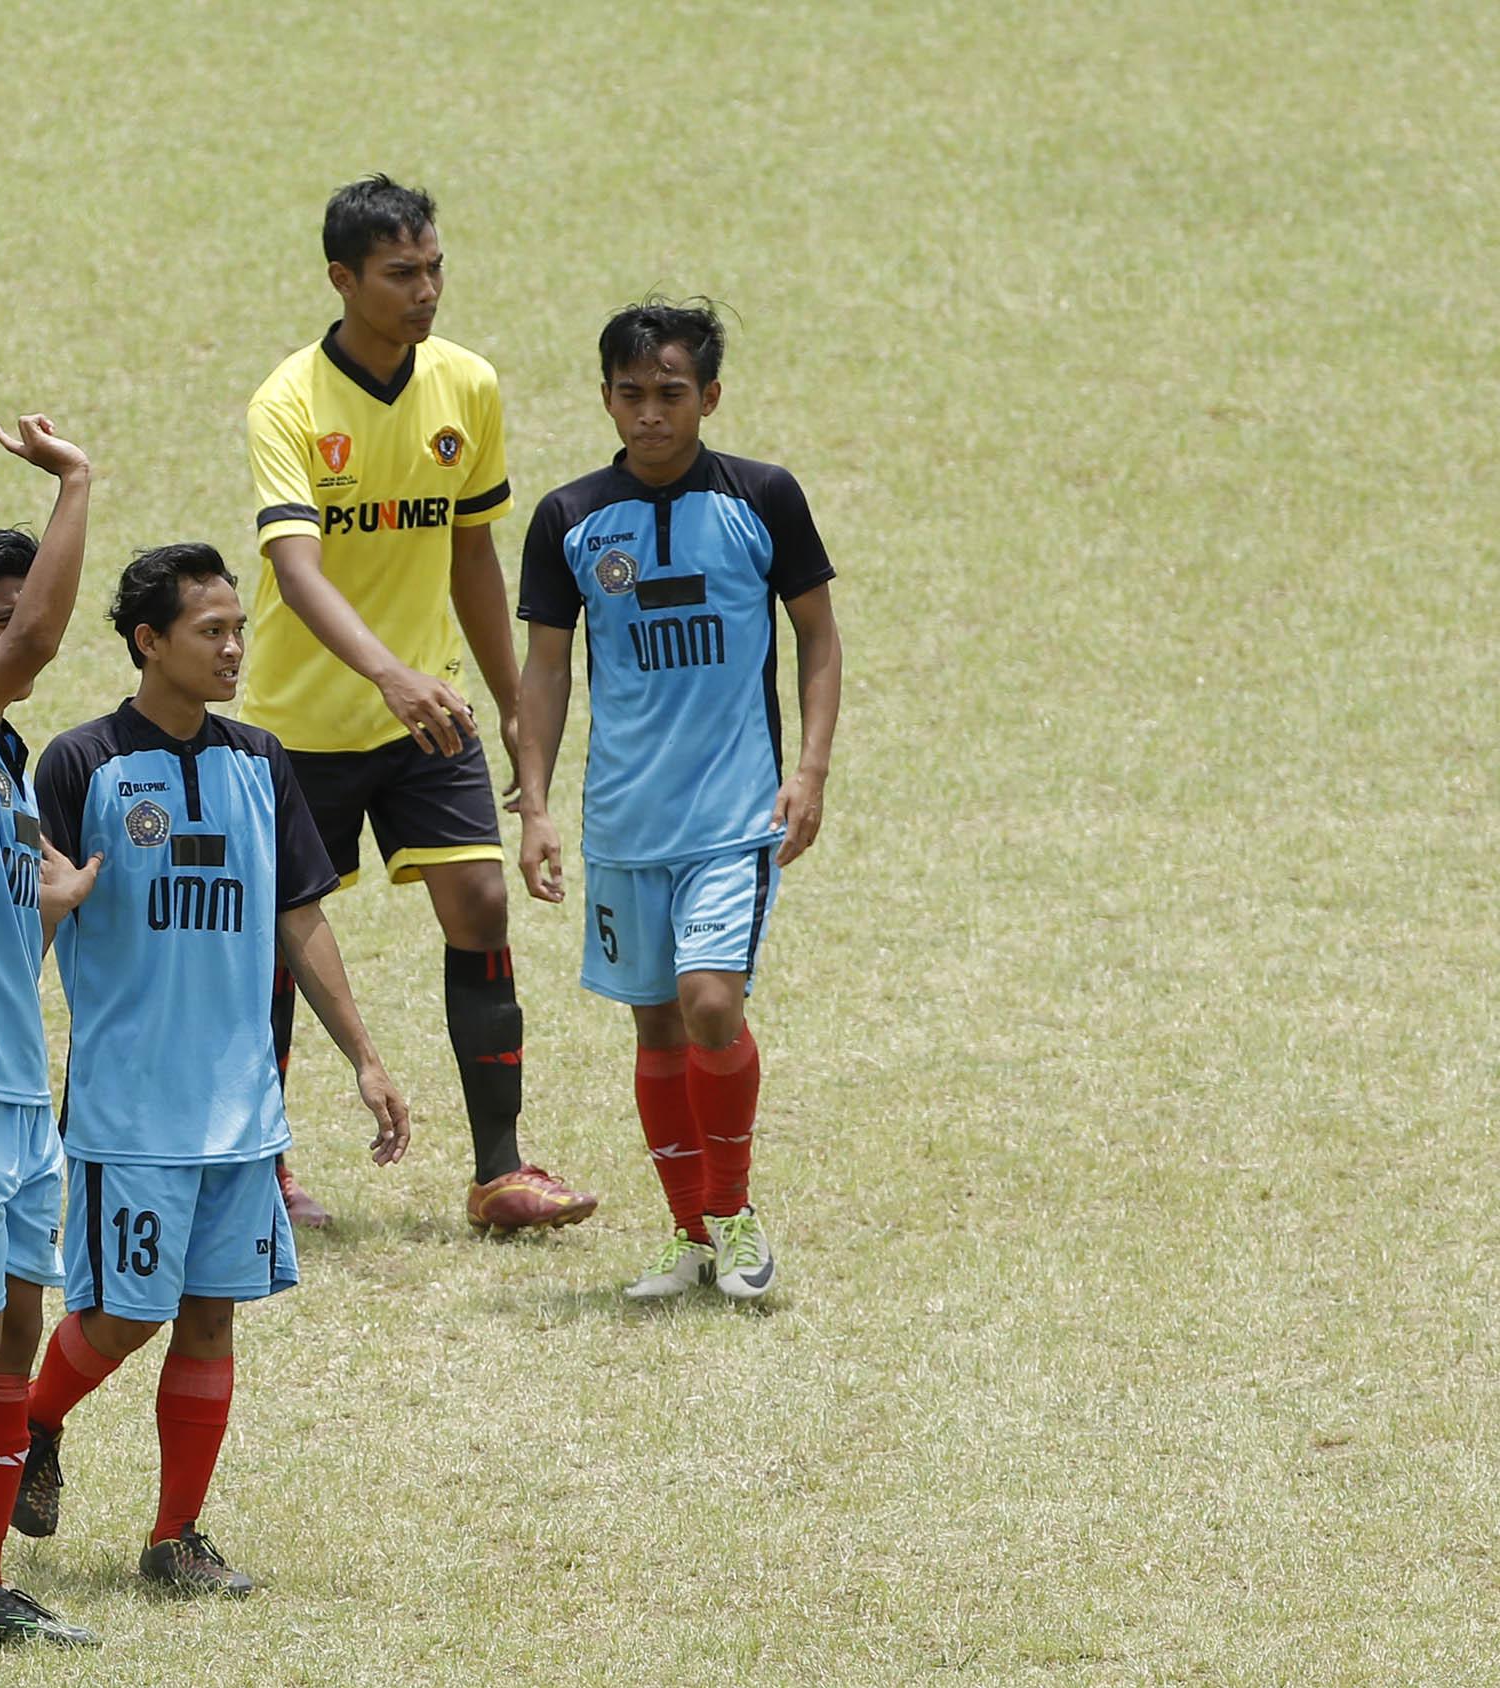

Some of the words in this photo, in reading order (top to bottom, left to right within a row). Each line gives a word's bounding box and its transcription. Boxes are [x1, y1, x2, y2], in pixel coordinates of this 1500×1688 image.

[324, 505, 354, 534] PS
[359, 497, 450, 532] UNMER
[628, 614, 725, 672] UMM
[148, 876, 243, 932] UMM
[595, 904, 618, 964] 5
[111, 1207, 161, 1277] 13
